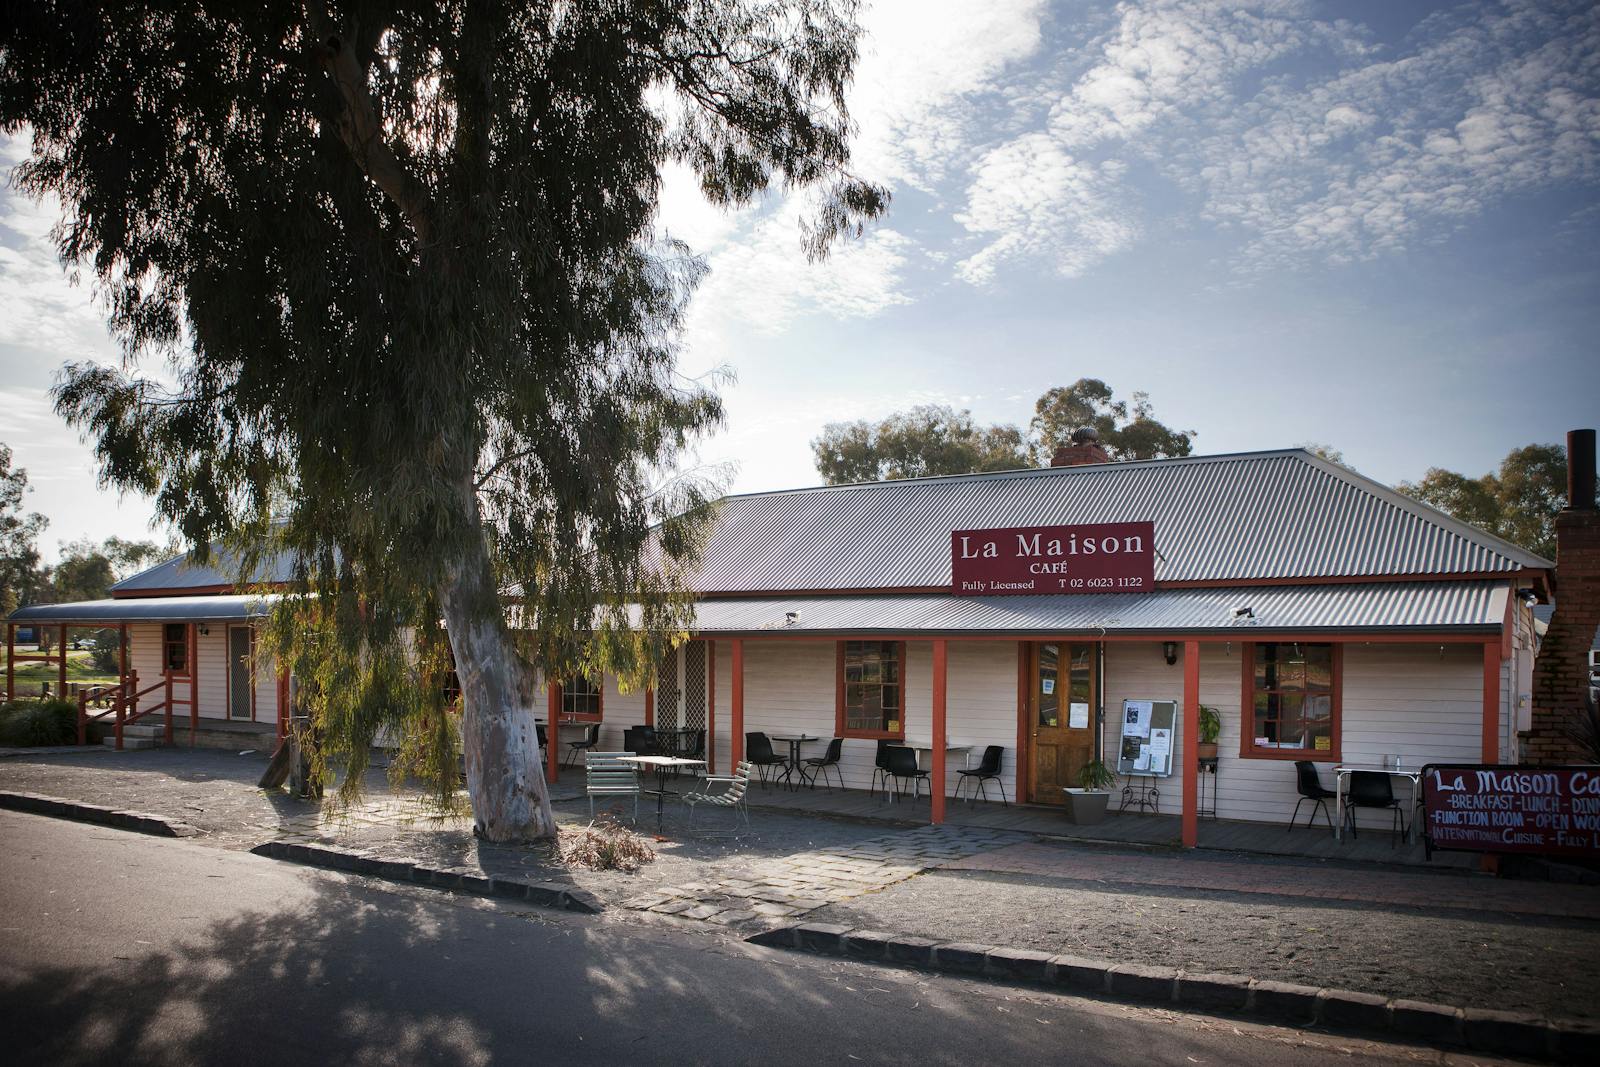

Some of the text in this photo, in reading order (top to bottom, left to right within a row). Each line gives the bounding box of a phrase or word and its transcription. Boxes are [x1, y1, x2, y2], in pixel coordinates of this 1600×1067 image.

[961, 533, 1144, 559] La Maison
[1030, 560, 1068, 574] CAFÉ
[962, 580, 1035, 592] Fully Licensed
[1059, 577, 1143, 588] T 02 6023 1122
[1434, 770, 1466, 792] La
[1476, 770, 1562, 796] Maison
[1492, 811, 1525, 827] ROOM
[1535, 813, 1569, 830] OPEN
